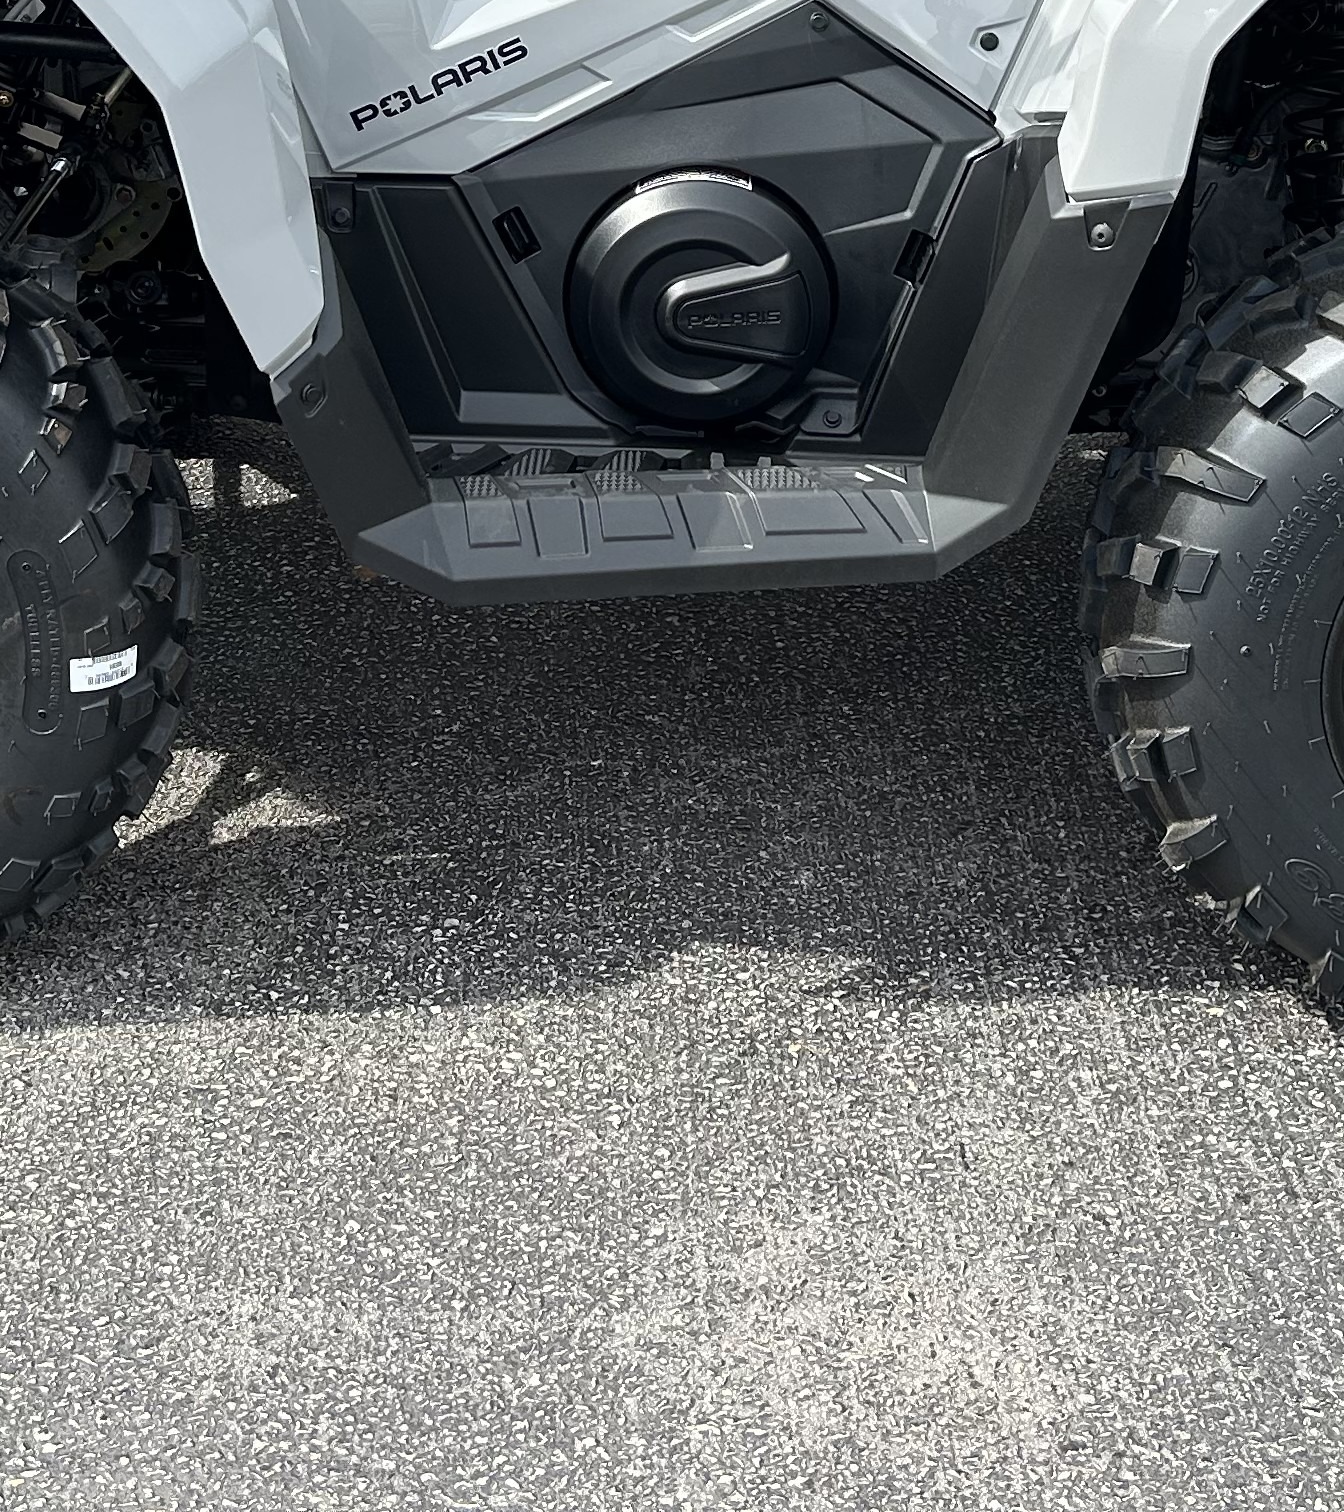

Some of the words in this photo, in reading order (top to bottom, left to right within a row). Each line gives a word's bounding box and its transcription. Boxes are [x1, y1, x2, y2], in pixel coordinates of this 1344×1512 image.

[348, 35, 530, 132] POLARIS
[687, 311, 782, 329] POLARIS
[1301, 471, 1339, 503] NHS
